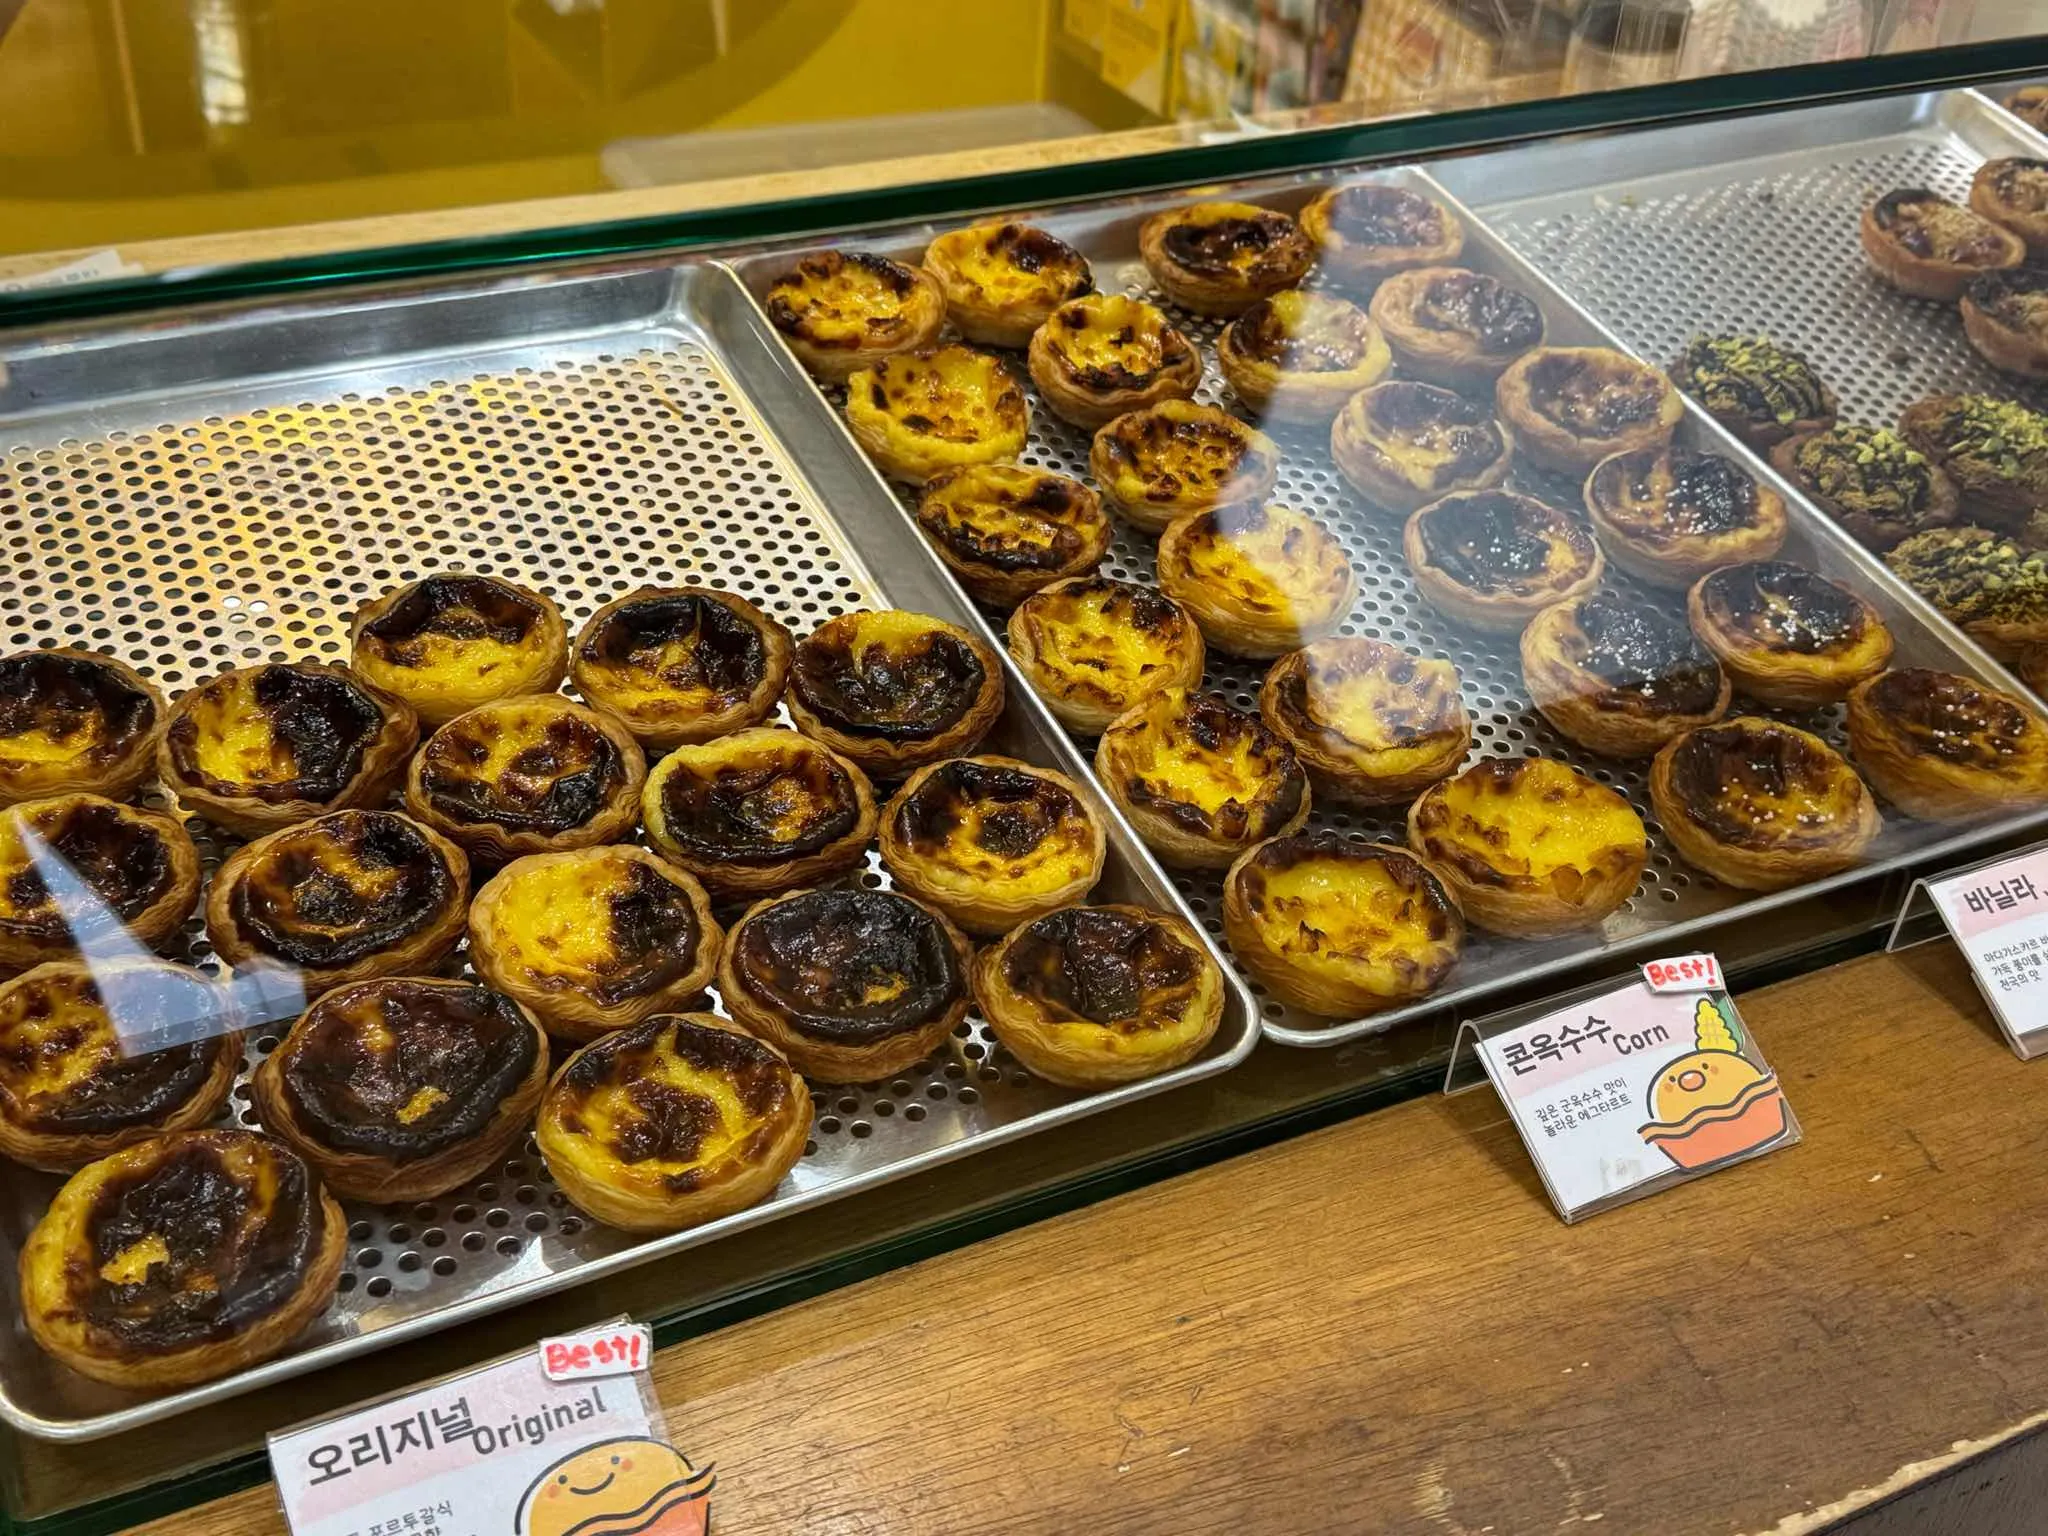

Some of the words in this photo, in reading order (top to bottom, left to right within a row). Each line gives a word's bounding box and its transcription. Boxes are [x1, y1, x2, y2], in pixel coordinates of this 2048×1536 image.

[1963, 874, 2039, 913] 바닐라
[1647, 957, 1715, 986] Best!
[1503, 1015, 1611, 1076] 콘옥수수
[1613, 1024, 1670, 1055] Corn
[1536, 1104, 1559, 1122] 깊은
[1560, 1088, 1602, 1113] 군옥수수
[1604, 1077, 1628, 1096] 맛이
[1544, 1114, 1578, 1137] 놀라운
[1578, 1093, 1632, 1120] 에그타르트
[545, 1335, 640, 1374] Best!
[307, 1396, 474, 1486] 오리지널
[472, 1386, 608, 1455] Original
